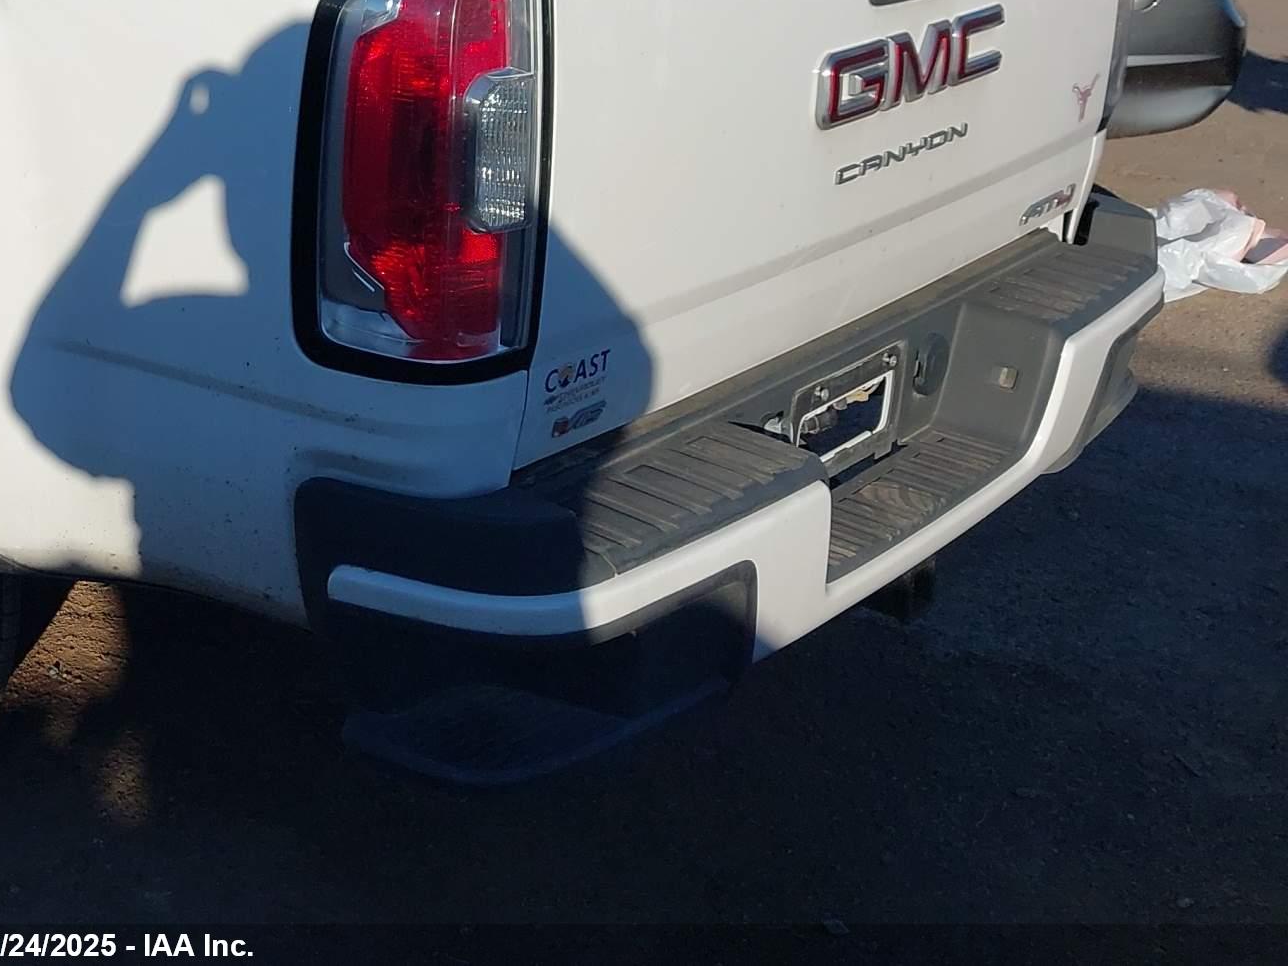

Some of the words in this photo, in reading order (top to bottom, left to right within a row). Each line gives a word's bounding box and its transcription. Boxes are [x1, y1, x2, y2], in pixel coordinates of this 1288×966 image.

[815, 3, 1005, 130] GMC
[834, 122, 968, 185] CANYON
[1018, 183, 1076, 227] AT4
[544, 348, 611, 392] COAST
